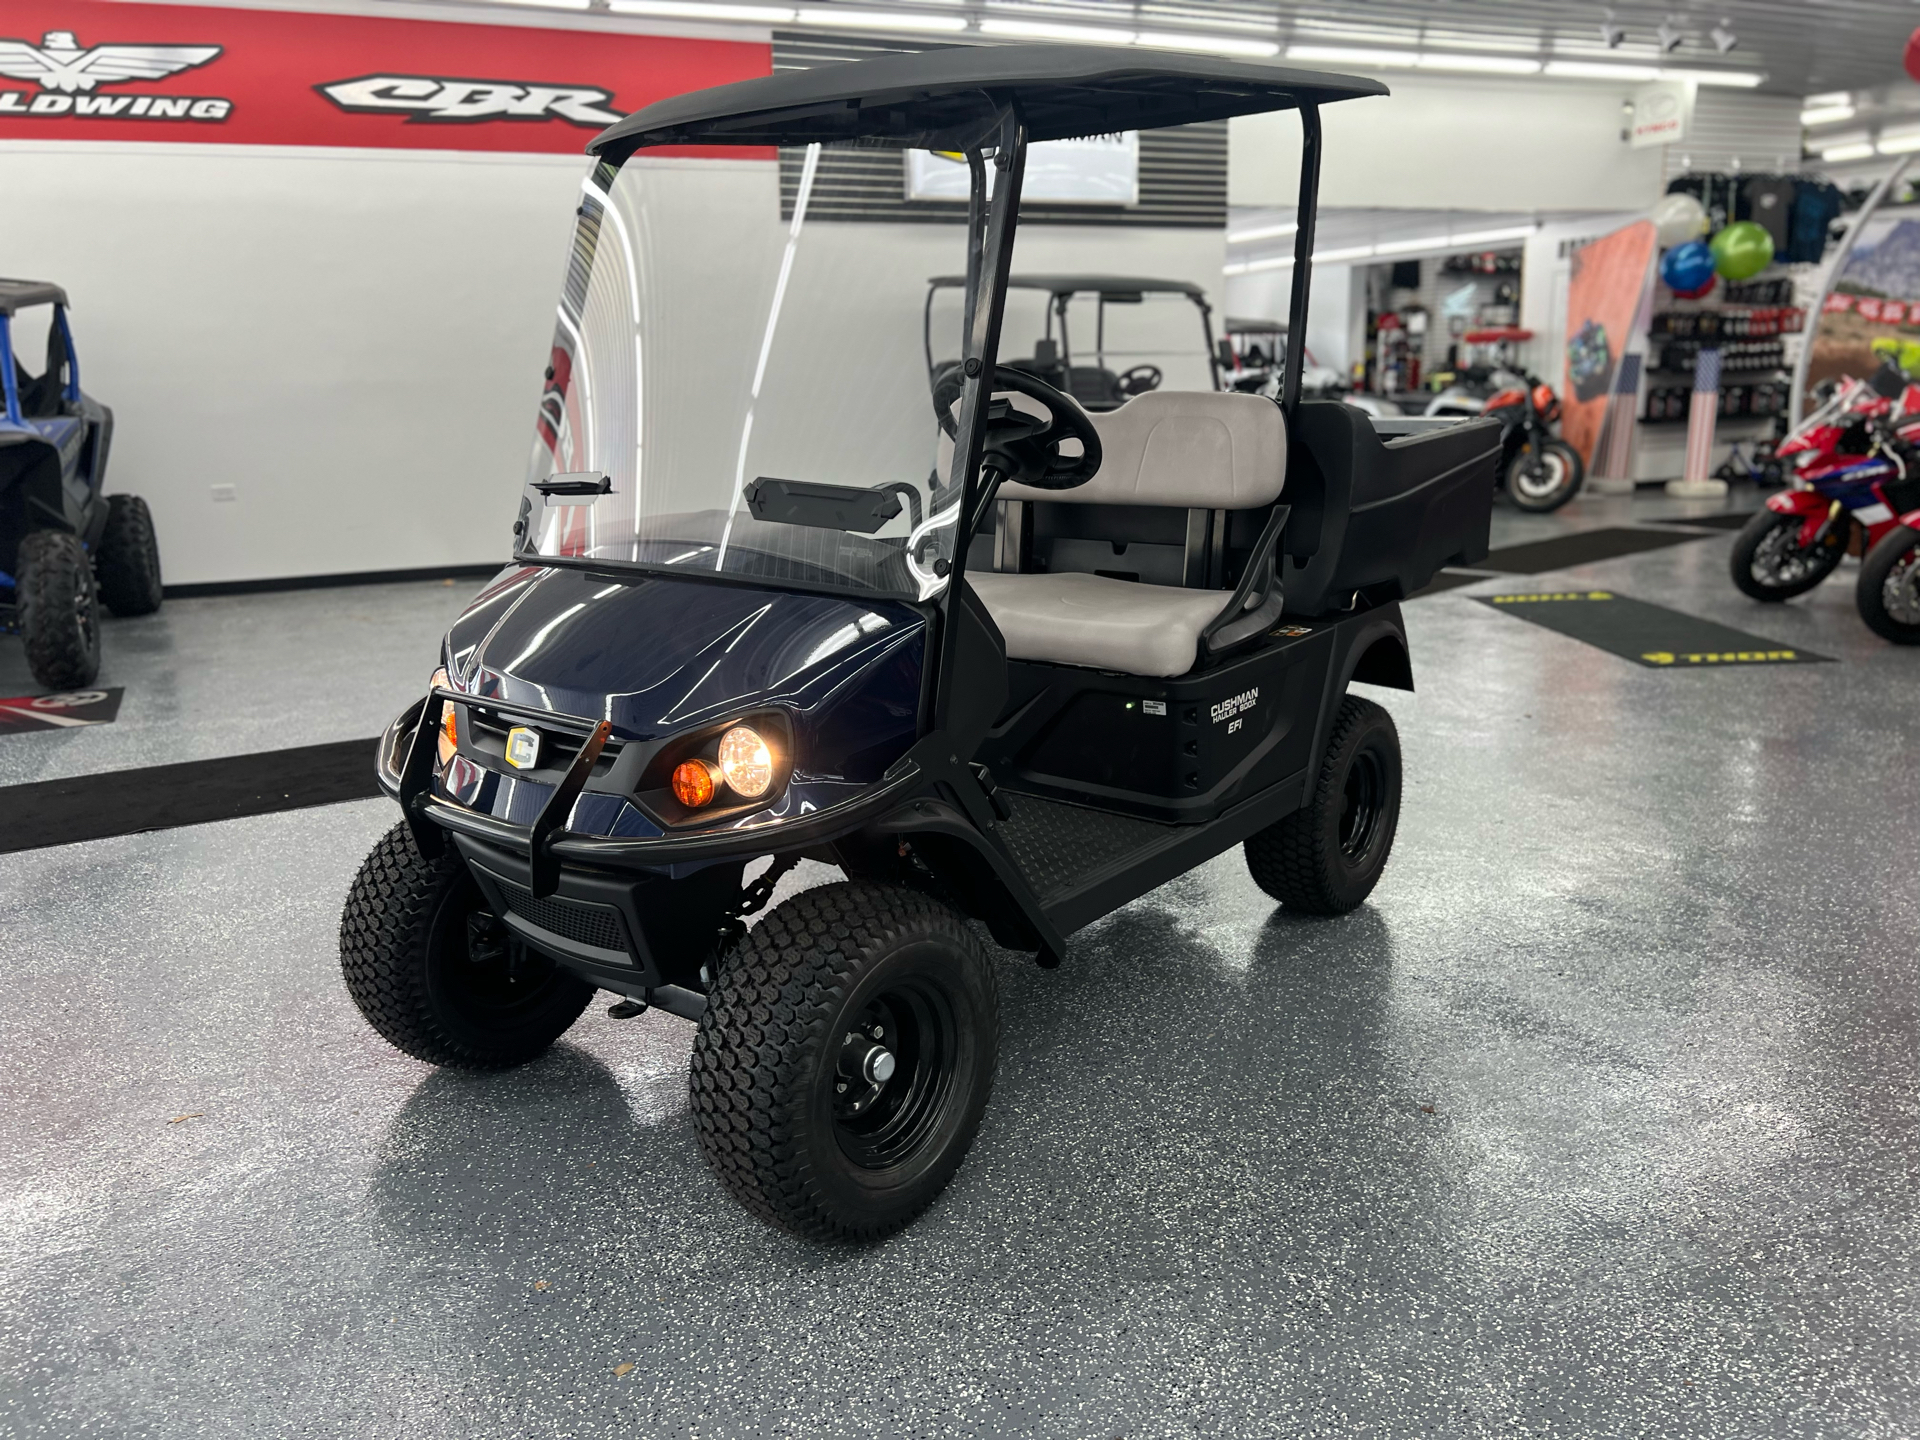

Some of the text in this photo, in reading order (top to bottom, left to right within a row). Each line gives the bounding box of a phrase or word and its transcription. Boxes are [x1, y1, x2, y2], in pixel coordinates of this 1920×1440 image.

[322, 76, 625, 124] CBR
[1210, 686, 1259, 717] CUSHMAN
[1212, 707, 1237, 724] HAULER
[1227, 717, 1243, 735] EFI
